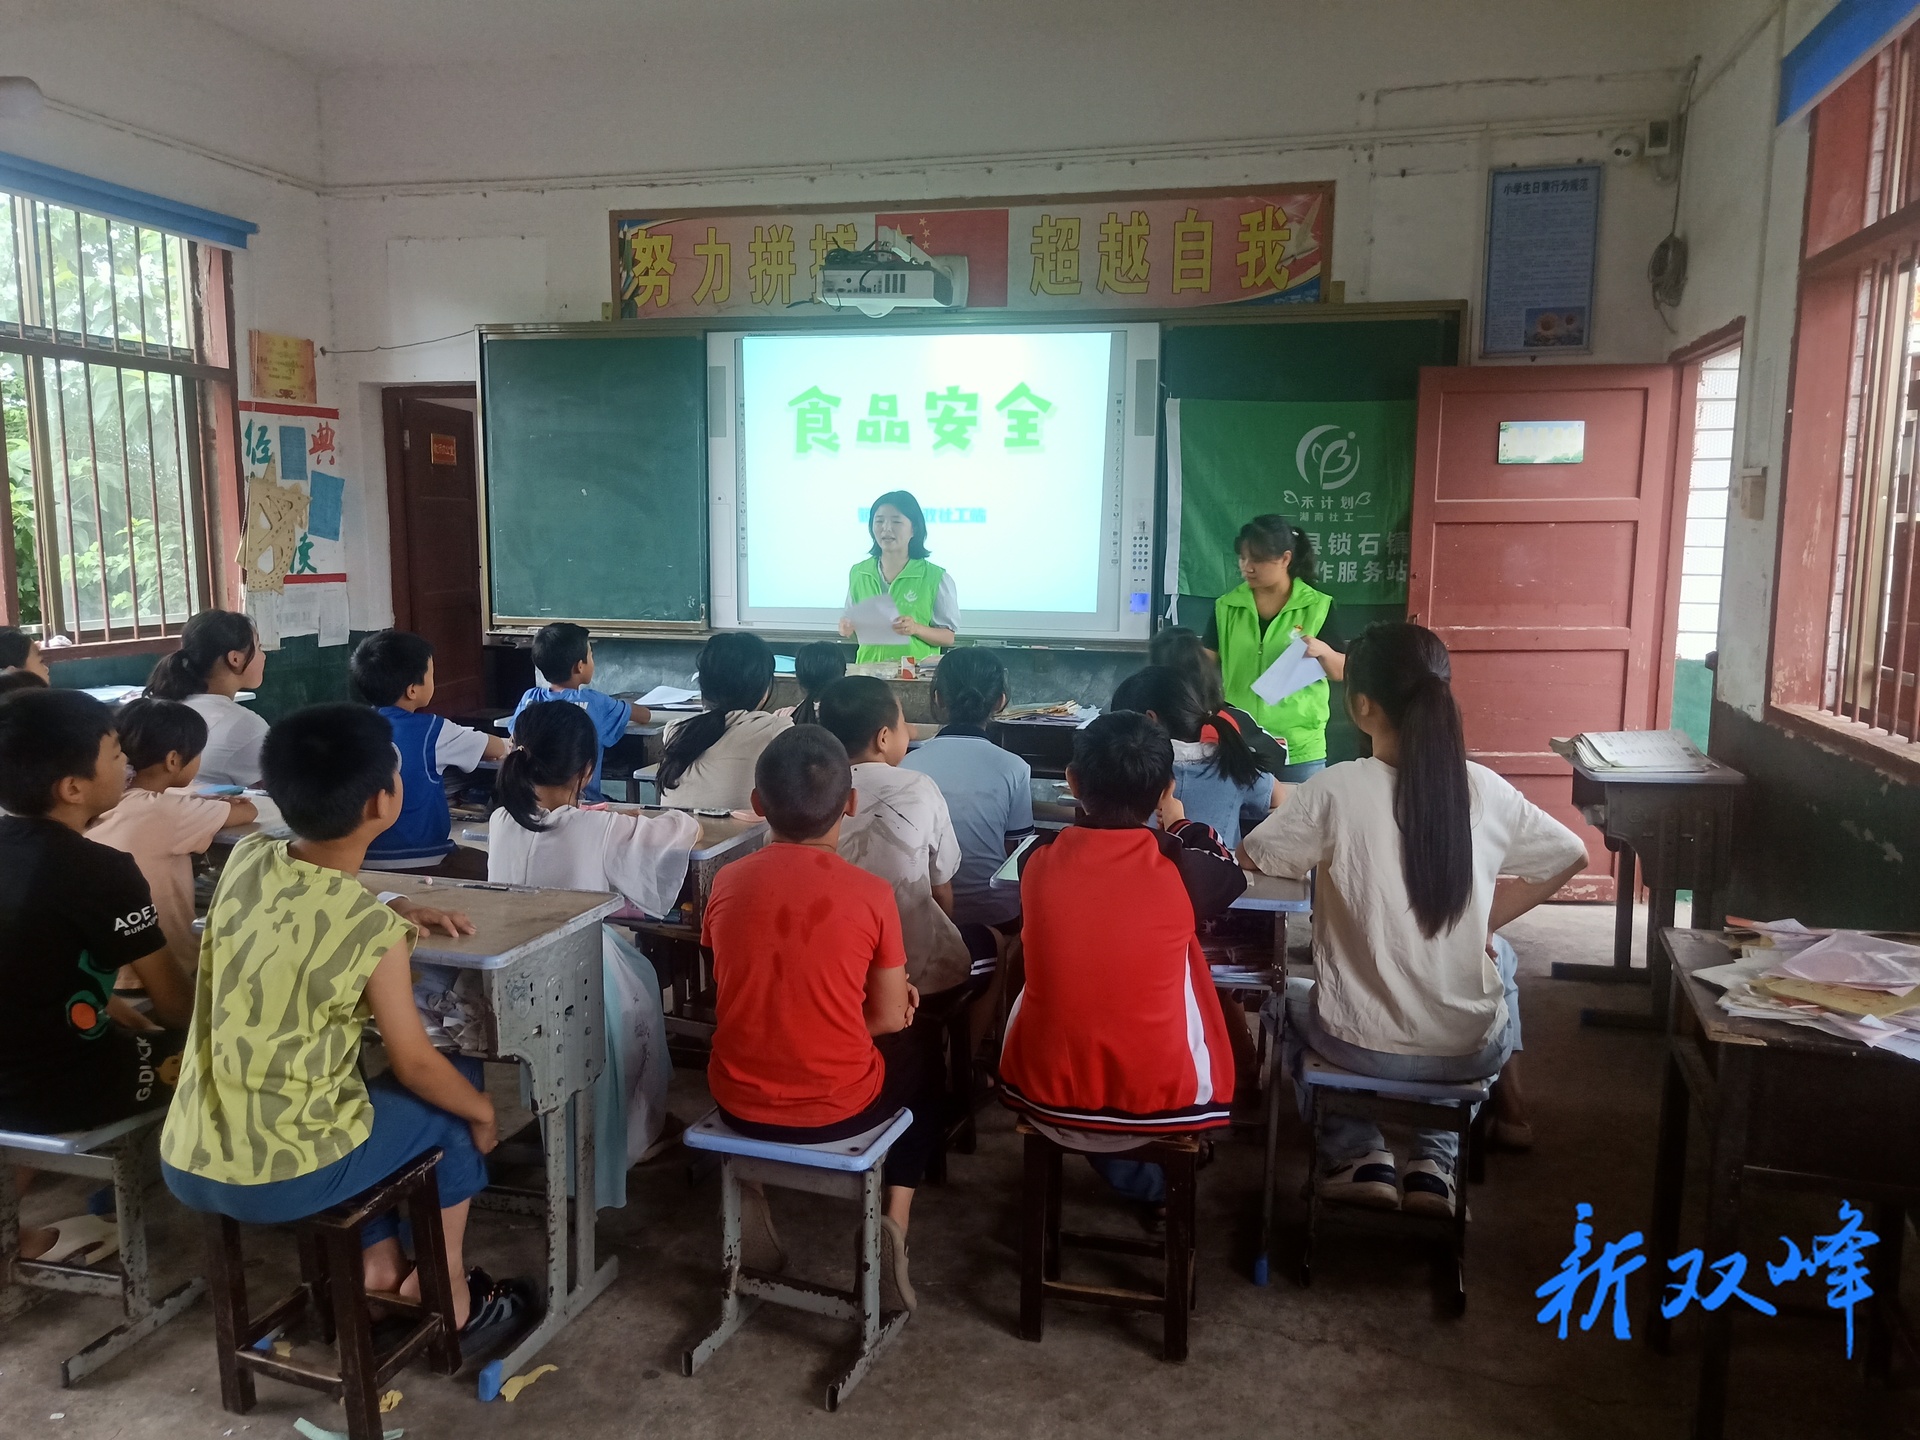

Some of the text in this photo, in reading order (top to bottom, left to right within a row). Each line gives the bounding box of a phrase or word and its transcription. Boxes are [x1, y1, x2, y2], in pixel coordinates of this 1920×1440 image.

[1029, 204, 1291, 296] 超越自我
[787, 381, 1052, 454] 食品安全
[308, 421, 336, 466] 典
[1299, 512, 1354, 522] 湖南社工
[1300, 496, 1355, 510] 禾计划
